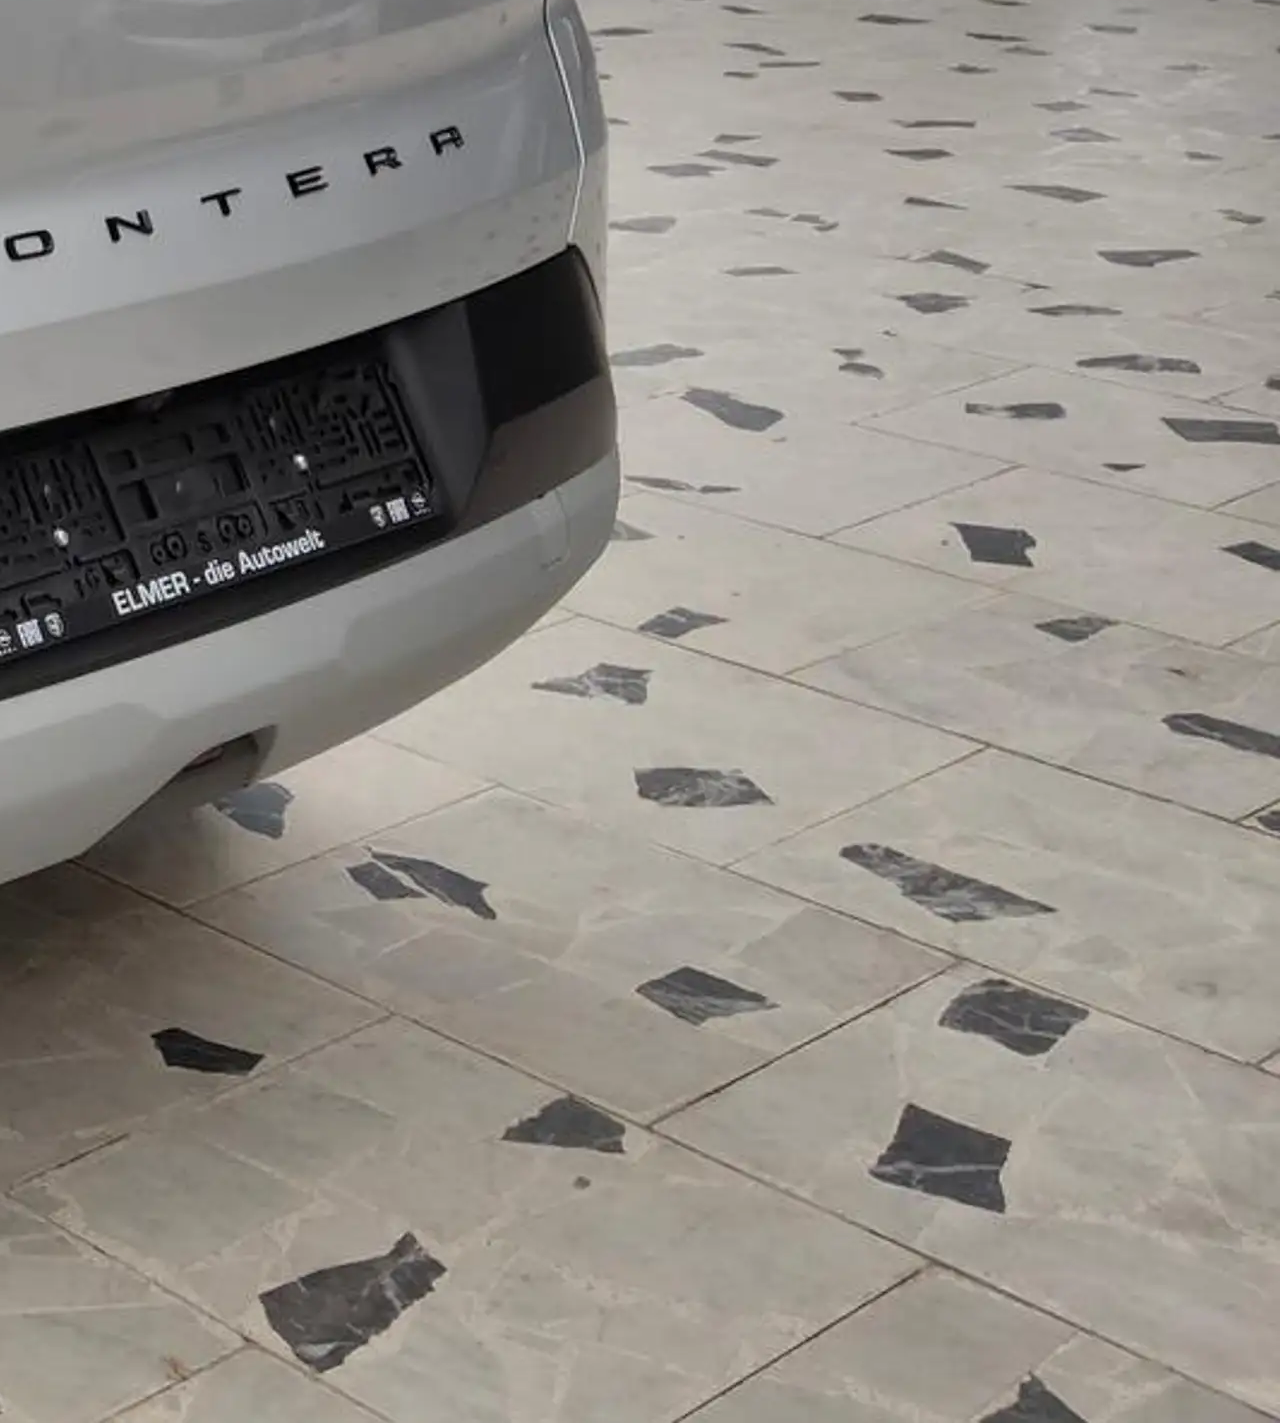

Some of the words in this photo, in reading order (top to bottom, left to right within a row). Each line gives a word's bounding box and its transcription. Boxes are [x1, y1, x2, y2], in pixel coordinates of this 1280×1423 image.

[111, 570, 190, 616] ELMER
[204, 558, 236, 586] die
[239, 529, 325, 575] Autowelt
